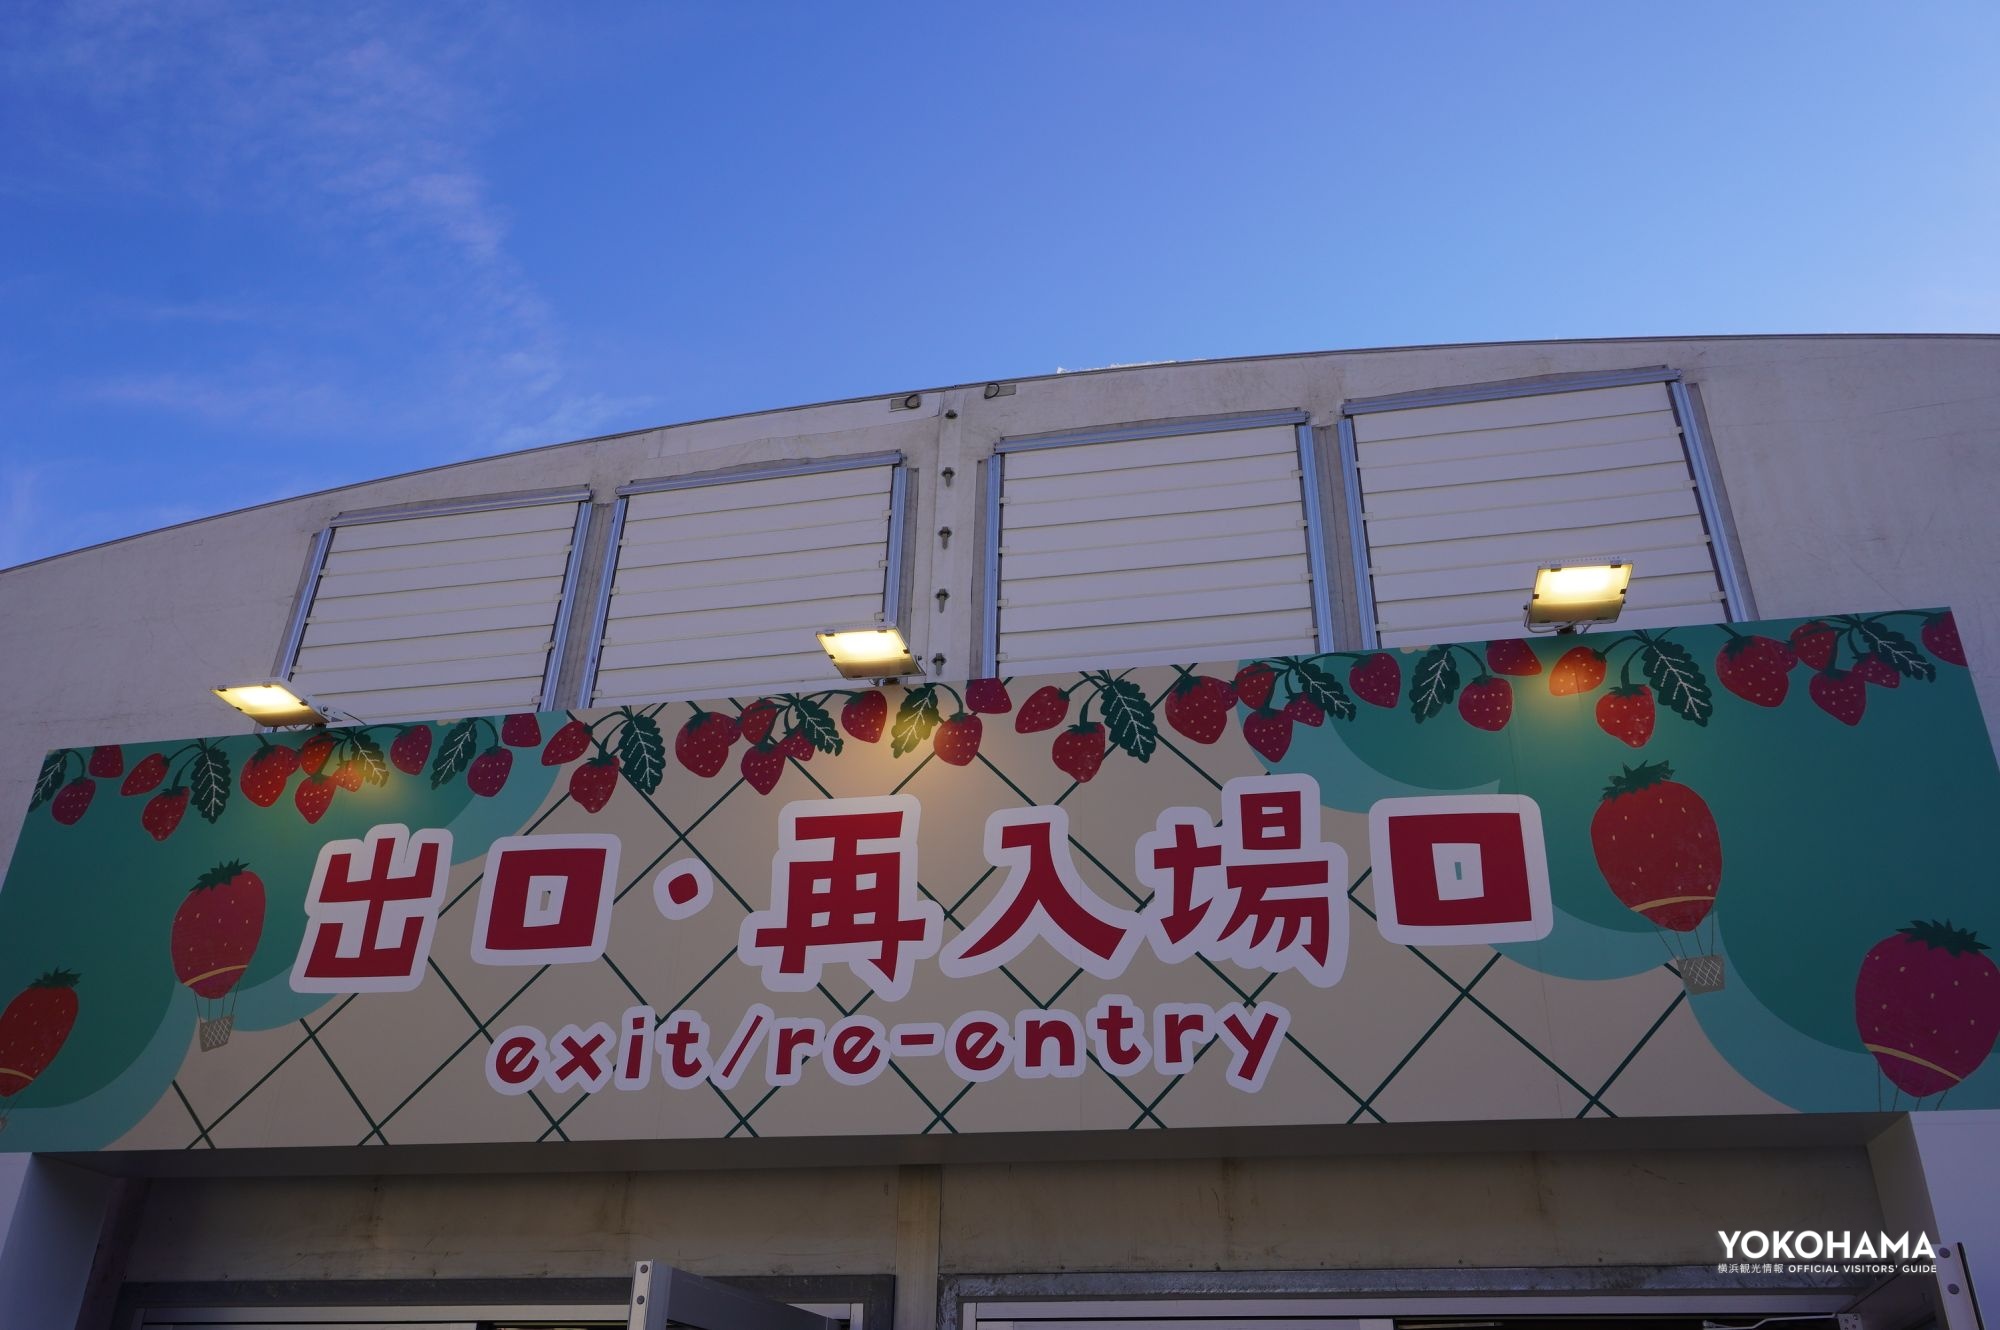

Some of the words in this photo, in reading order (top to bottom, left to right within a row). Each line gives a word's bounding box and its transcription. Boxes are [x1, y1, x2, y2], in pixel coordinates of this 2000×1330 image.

[303, 790, 1533, 983] 出口・再入場口
[495, 1005, 1279, 1084] exit/re-entry
